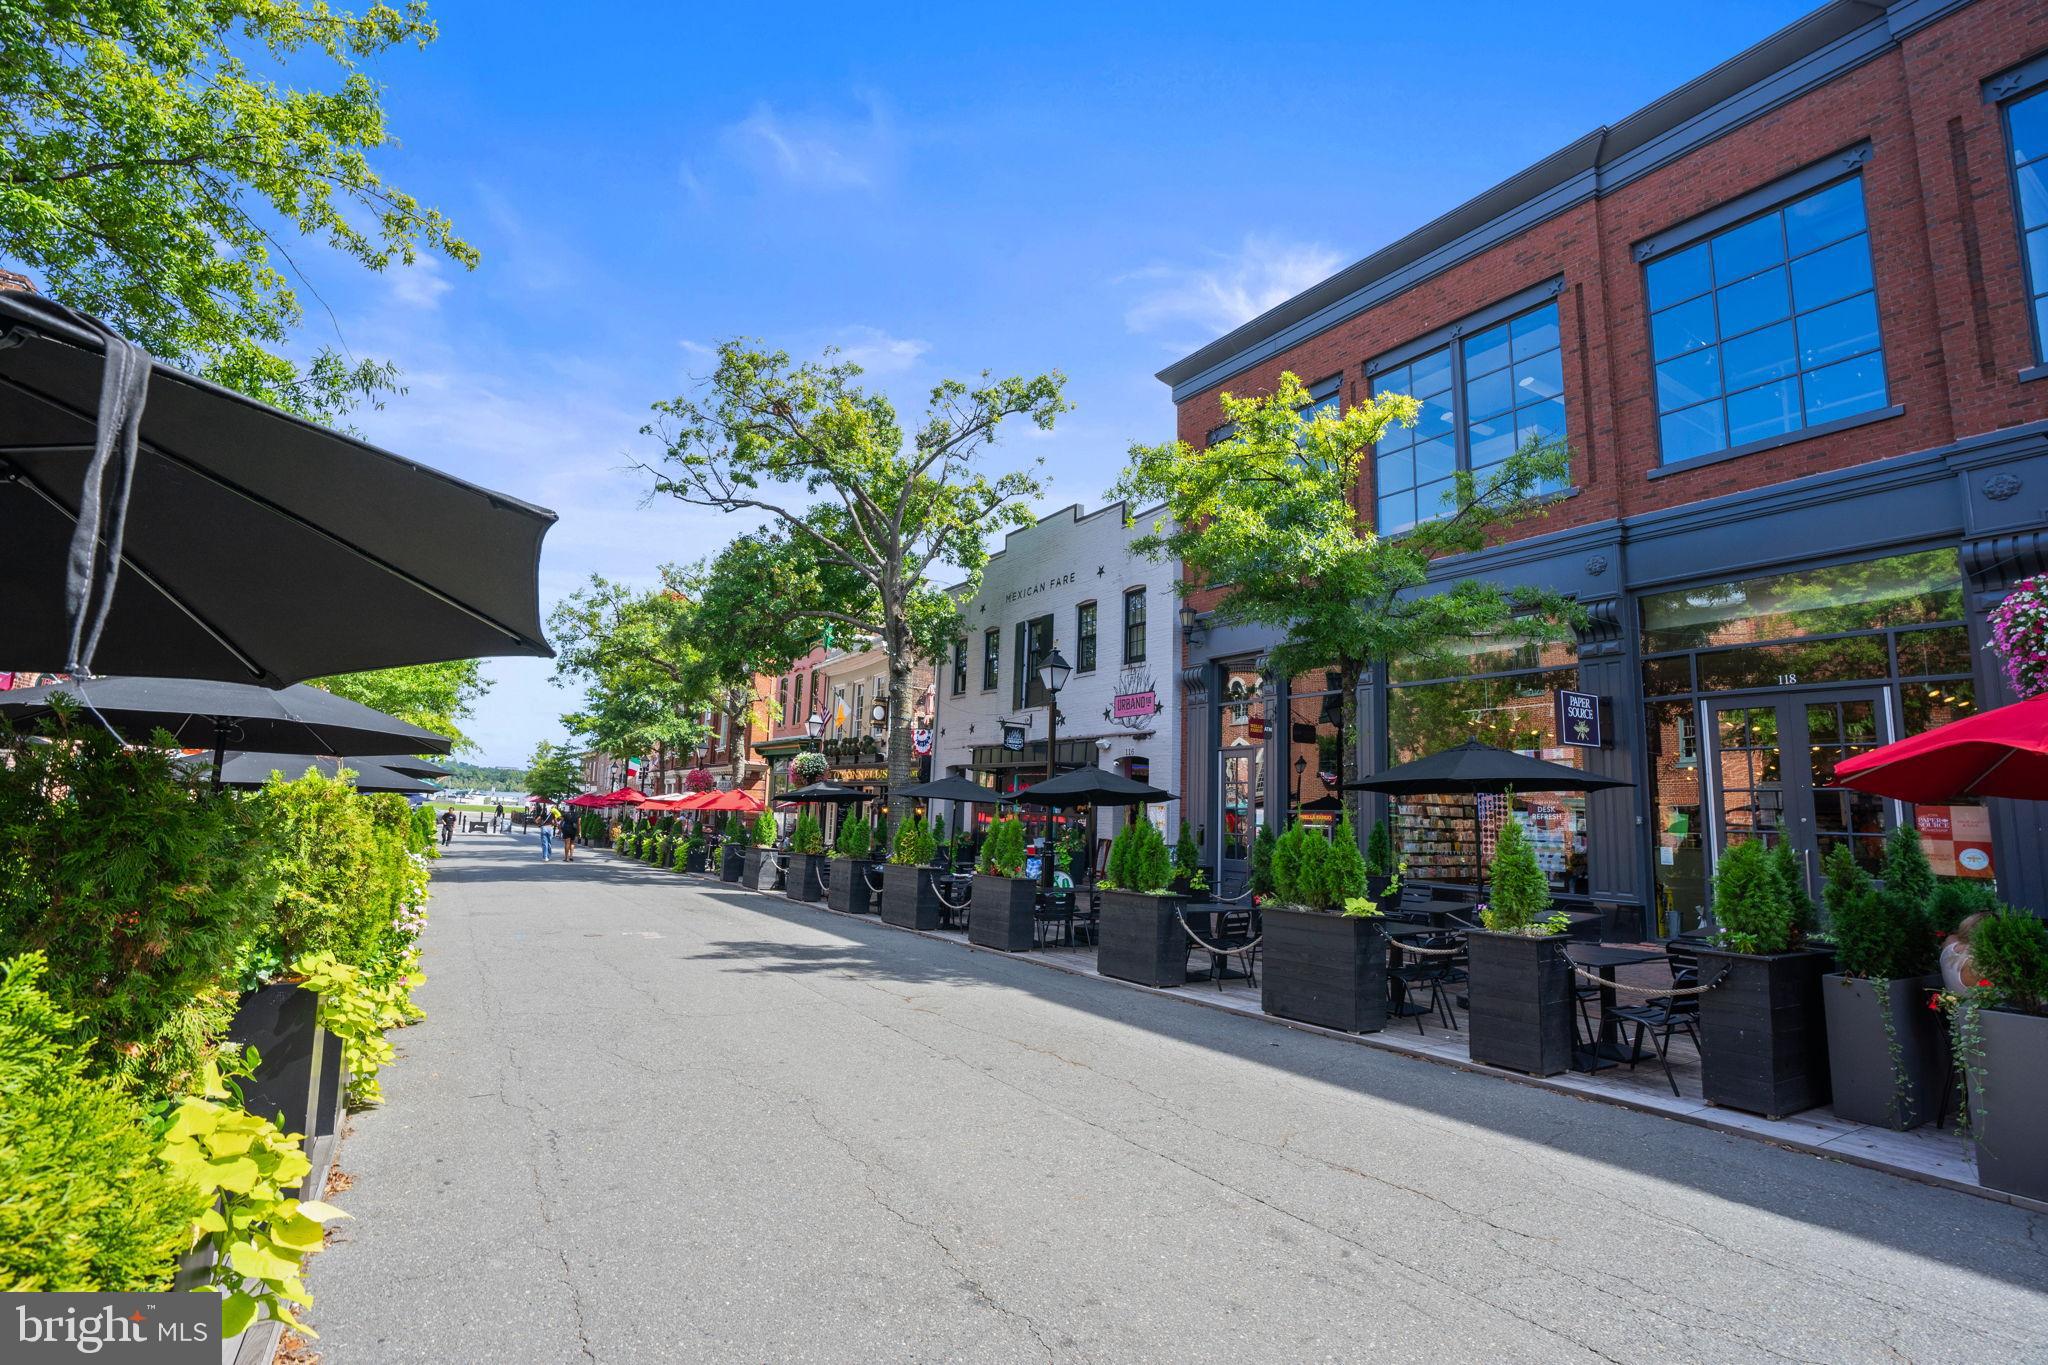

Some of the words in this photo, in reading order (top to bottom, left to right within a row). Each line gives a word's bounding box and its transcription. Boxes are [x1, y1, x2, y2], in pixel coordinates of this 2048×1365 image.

[1005, 582, 1046, 603] MEXICAN
[1050, 572, 1076, 589] FARE
[1778, 673, 1797, 685] 118
[1117, 696, 1146, 711] URBANO
[1569, 695, 1591, 709] PAPER
[1568, 706, 1594, 720] SOURCE
[1125, 748, 1135, 756] 116
[1537, 805, 1556, 813] DESK
